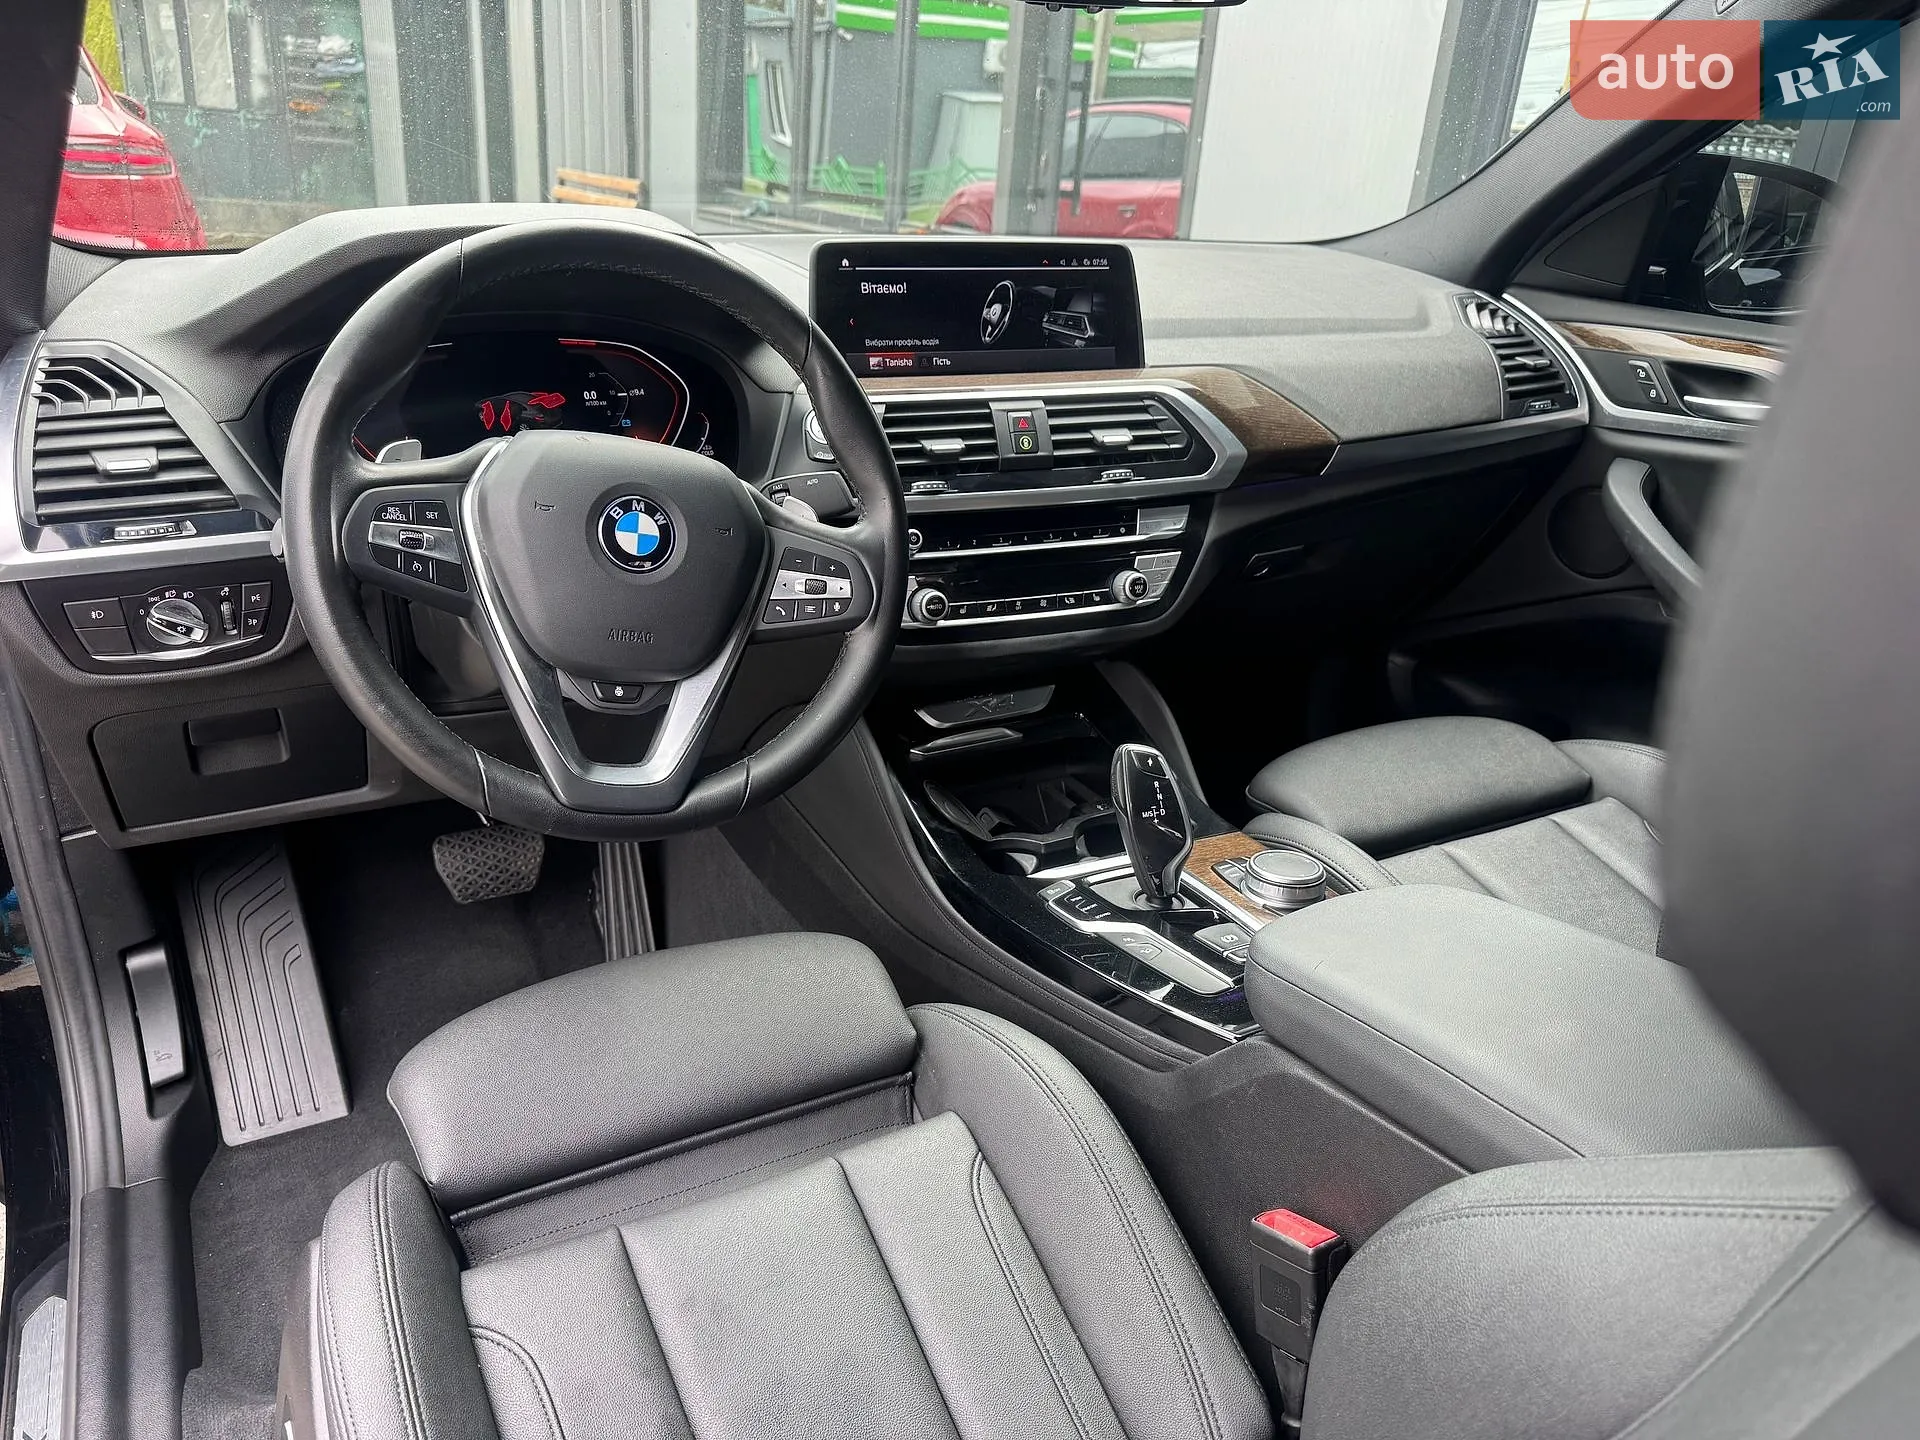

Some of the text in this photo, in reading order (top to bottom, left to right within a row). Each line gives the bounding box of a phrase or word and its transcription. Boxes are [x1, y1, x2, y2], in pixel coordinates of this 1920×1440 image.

[861, 282, 907, 294] Вітаємо!
[865, 337, 940, 347] Вибрати профіль водія
[885, 357, 913, 367] Tanisha
[933, 357, 951, 366] Гість
[583, 391, 597, 400] 0.0
[387, 506, 400, 514] RES
[610, 500, 667, 526] BMW
[381, 512, 408, 521] CANCEL
[425, 511, 439, 520] SET
[608, 628, 654, 645] AIRBAG
